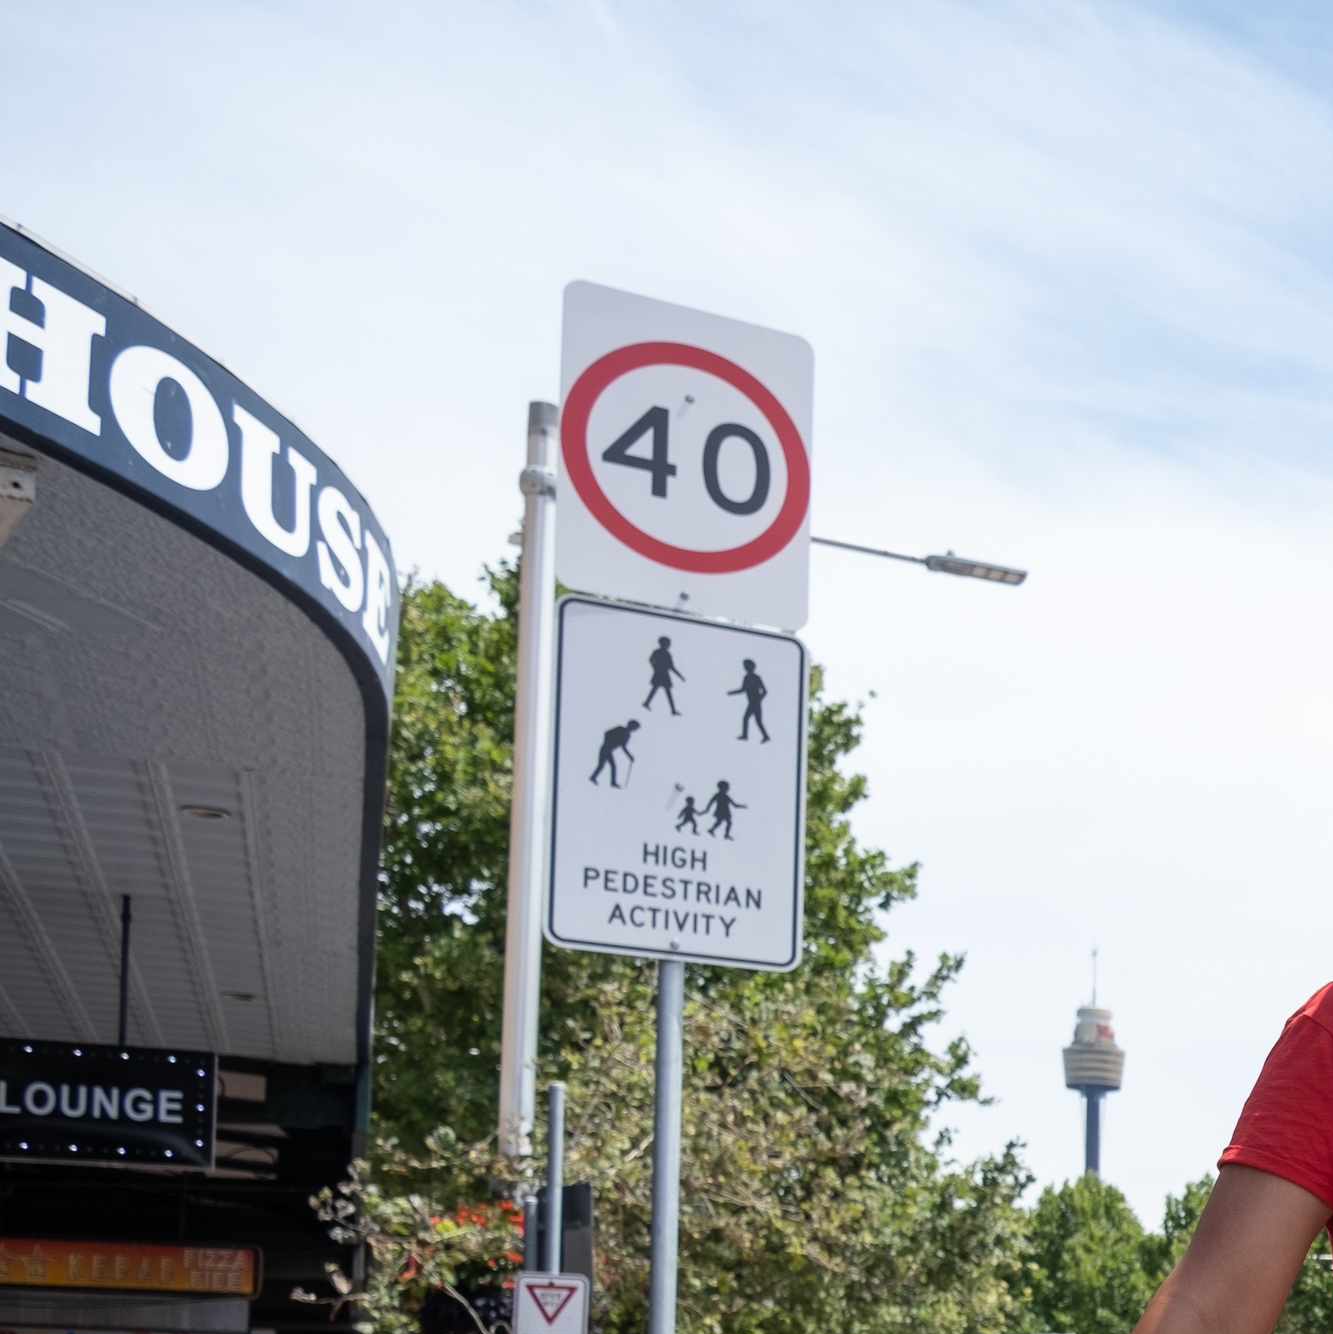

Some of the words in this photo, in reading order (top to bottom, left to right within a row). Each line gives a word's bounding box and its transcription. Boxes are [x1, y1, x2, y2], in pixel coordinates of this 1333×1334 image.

[0, 256, 393, 664] HOUSE
[602, 405, 771, 517] 40
[643, 842, 707, 872] HIGH
[583, 867, 762, 911] PEDESTRIAN
[608, 903, 737, 938] ACTIVITY
[0, 1080, 184, 1124] LOUNGE
[67, 1252, 175, 1284] KEBAB
[183, 1247, 249, 1271] PIZZA
[189, 1270, 242, 1292] PIDE
